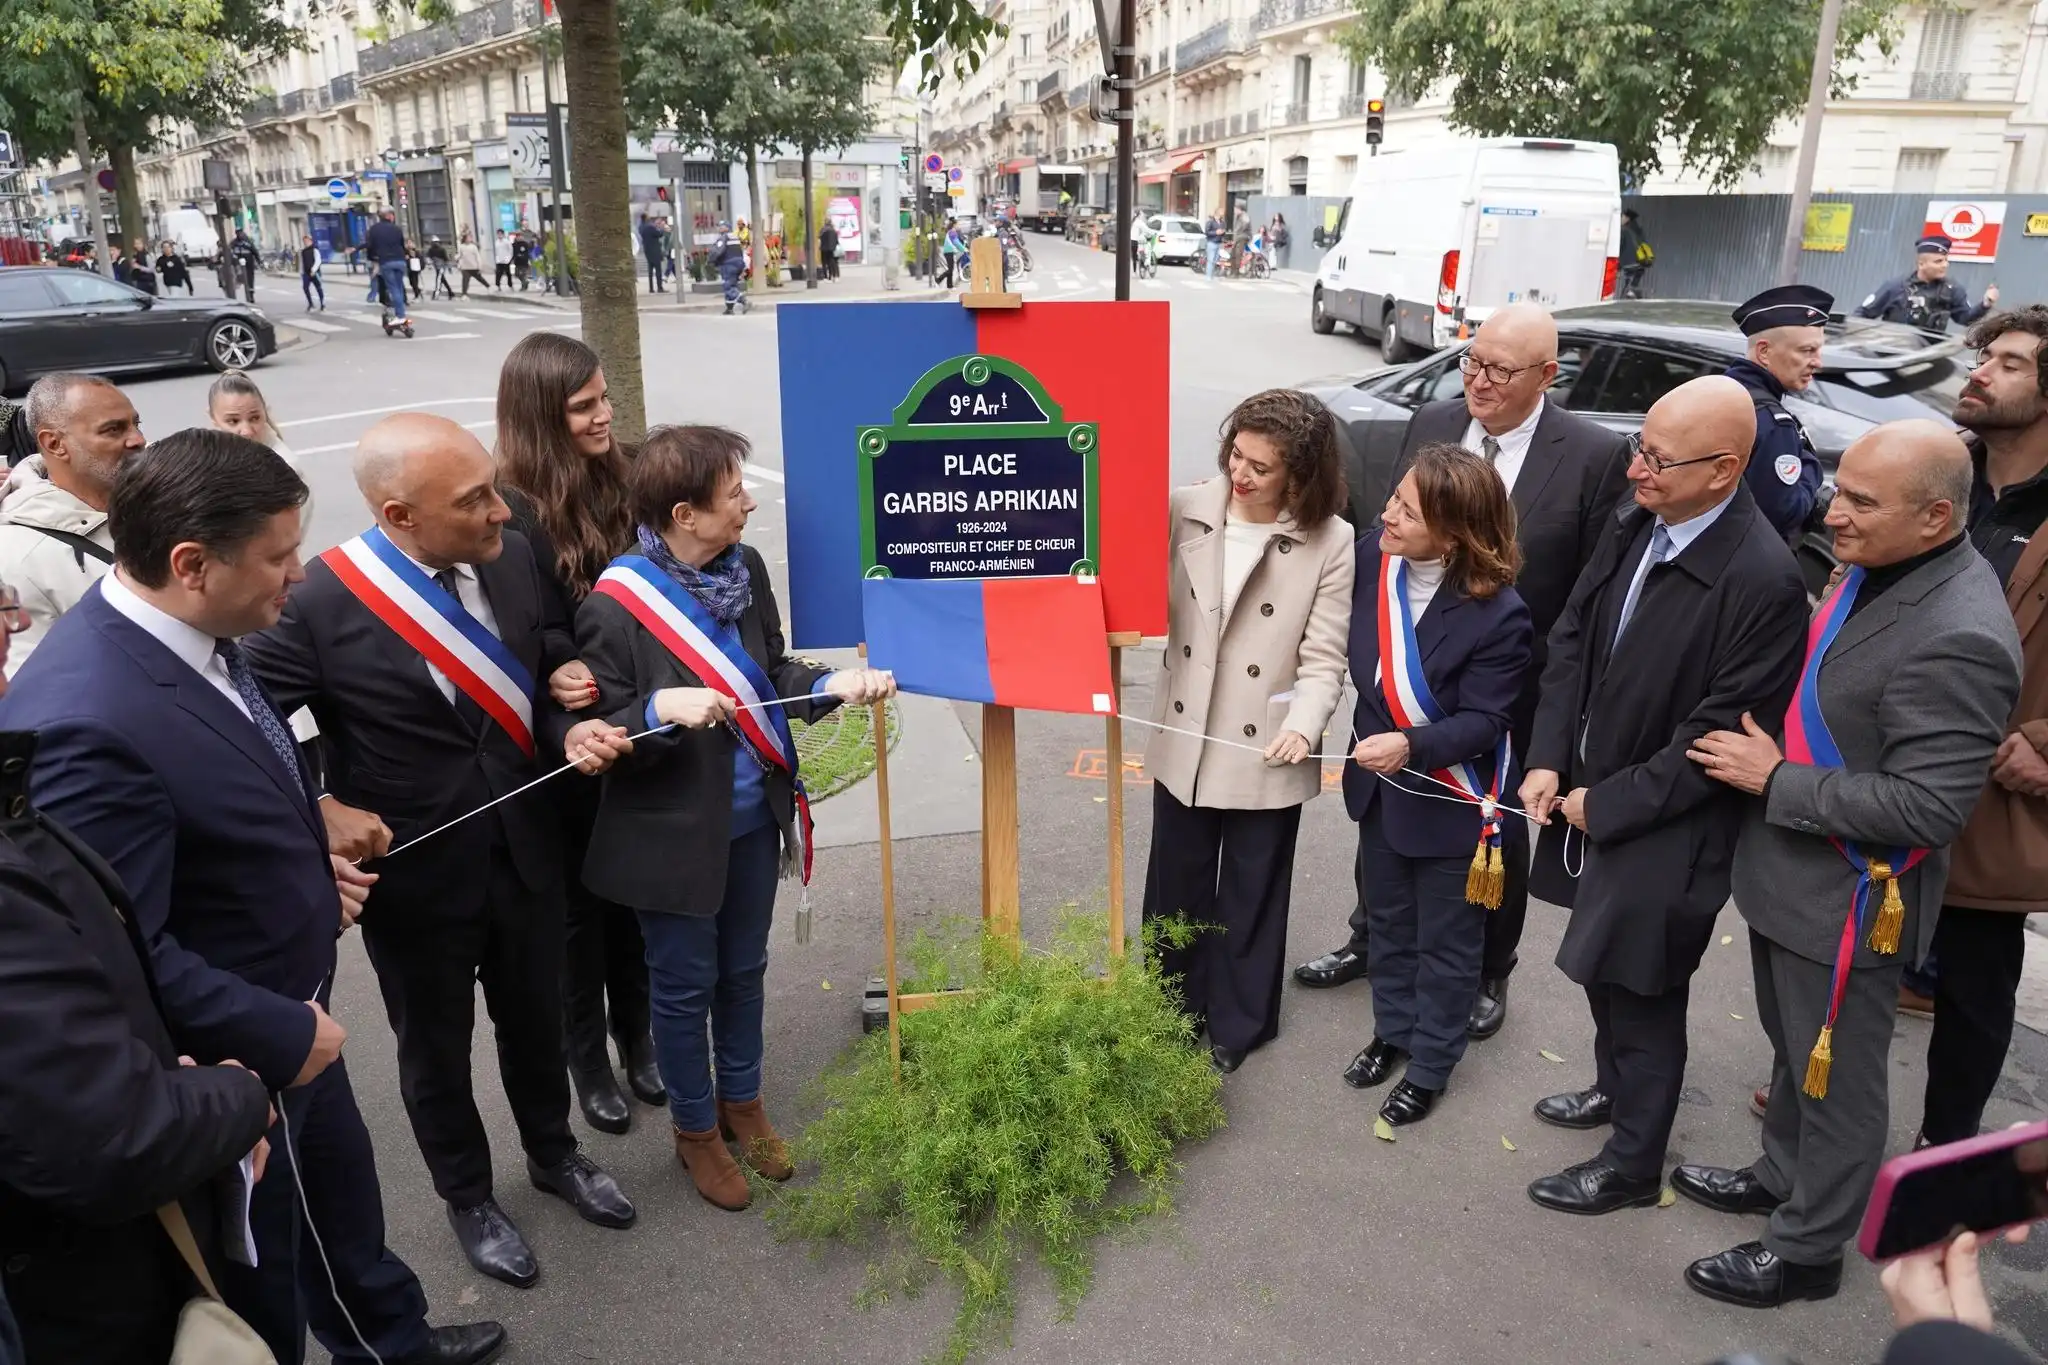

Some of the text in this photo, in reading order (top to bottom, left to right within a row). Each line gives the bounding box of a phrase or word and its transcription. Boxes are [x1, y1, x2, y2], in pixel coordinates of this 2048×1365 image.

[945, 454, 1016, 475] PLACE
[884, 489, 1077, 514] GARBIS APRIKIAN
[957, 522, 1007, 533] 1926-2024
[887, 539, 1075, 554] COMPOSITEUR ET CHEF DE CHŒUR
[930, 556, 1034, 572] FRANCO-ARMÉNIEN
